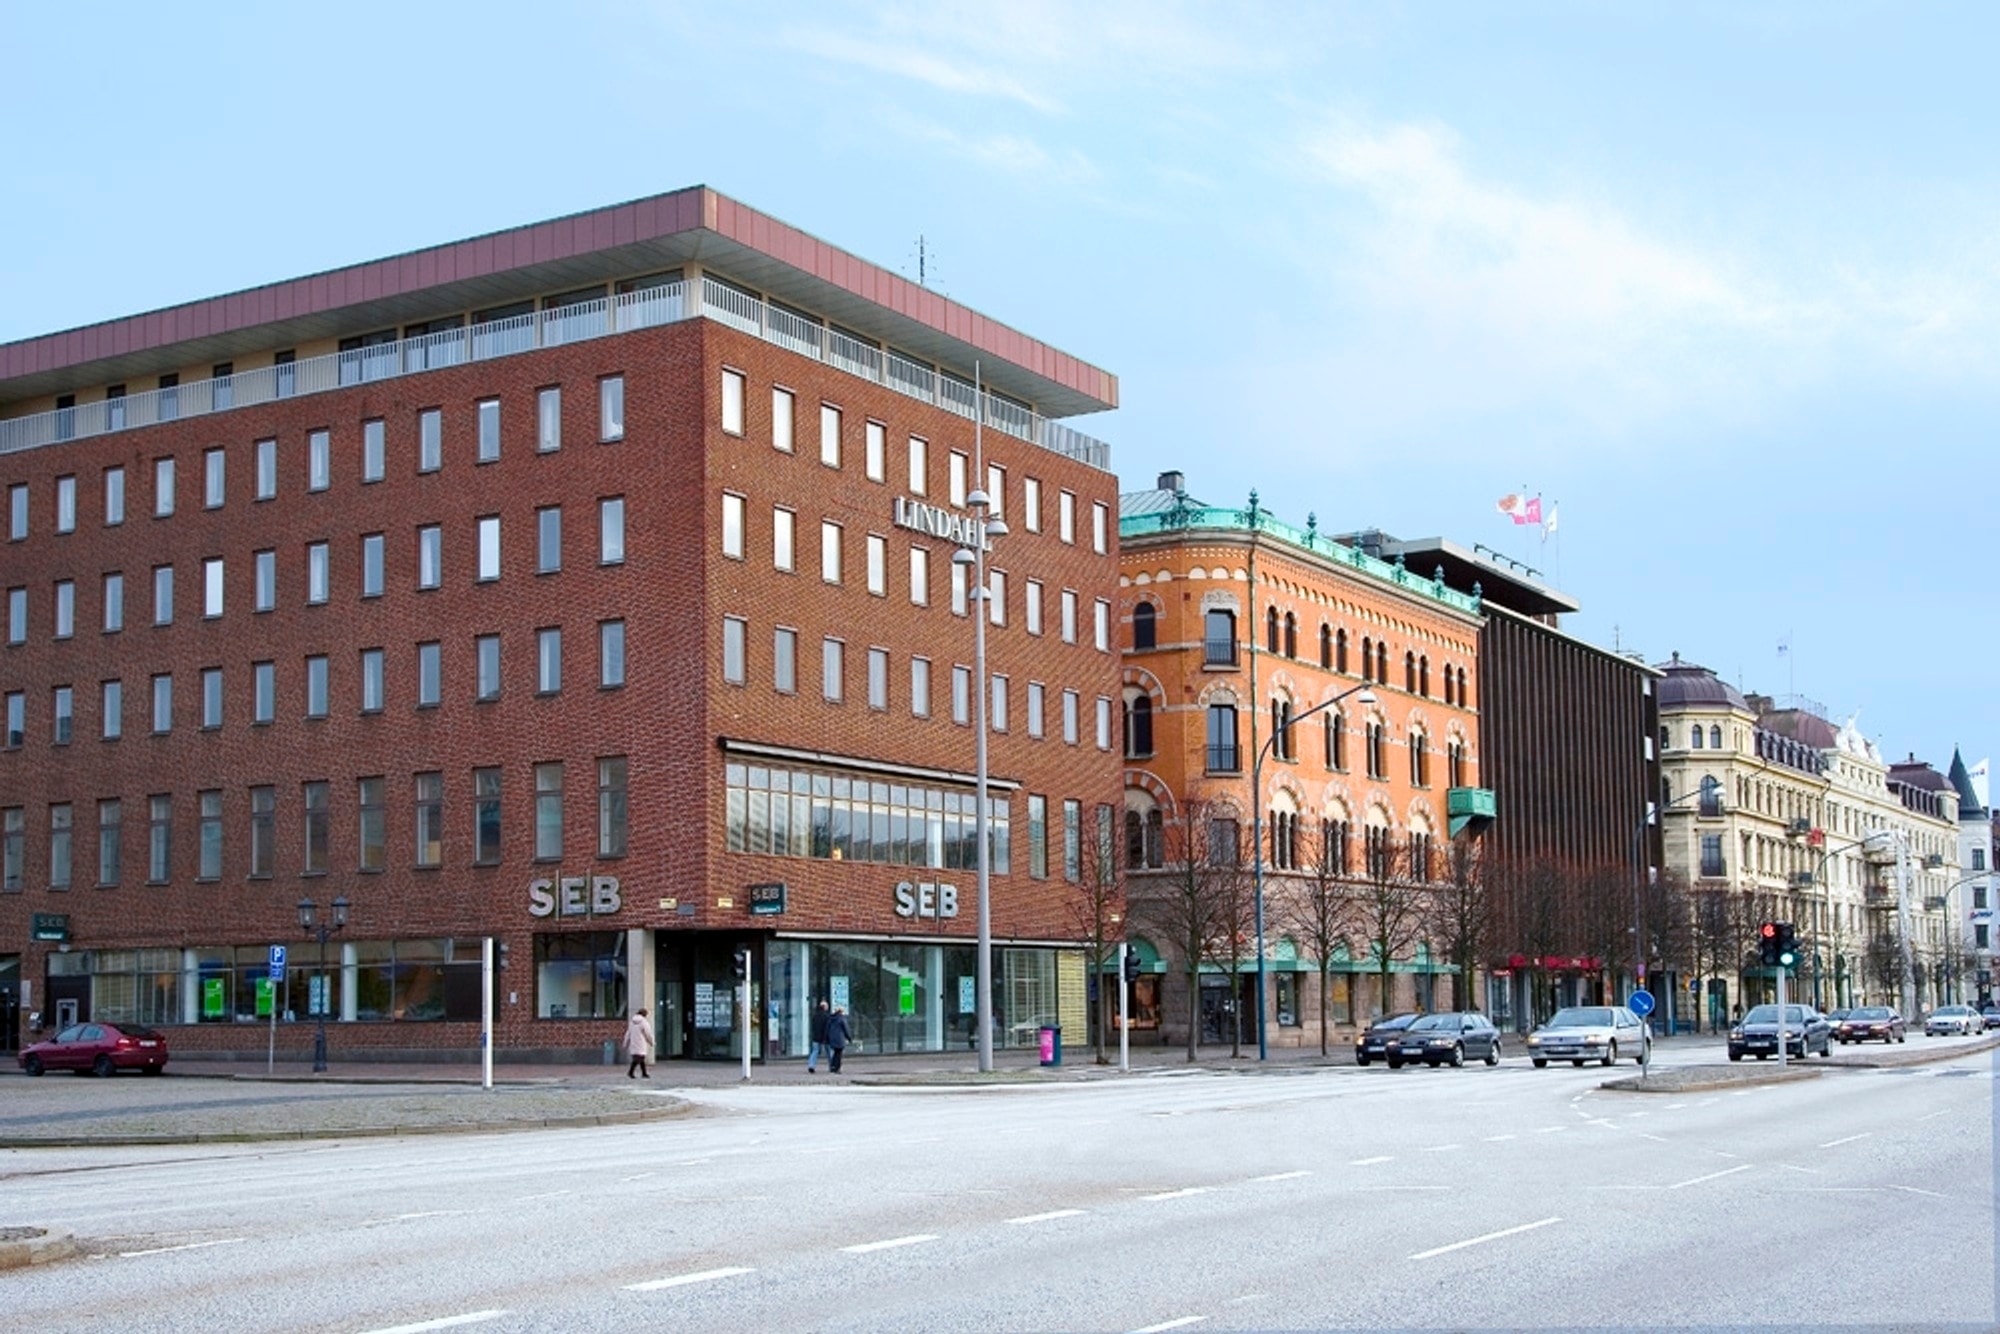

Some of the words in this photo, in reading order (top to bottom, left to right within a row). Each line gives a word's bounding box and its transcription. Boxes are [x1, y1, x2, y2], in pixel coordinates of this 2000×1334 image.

[894, 496, 992, 552] LINDAHL
[528, 876, 621, 917] SEB
[752, 887, 779, 900] SEB
[895, 881, 959, 917] SEB
[274, 947, 281, 961] P
